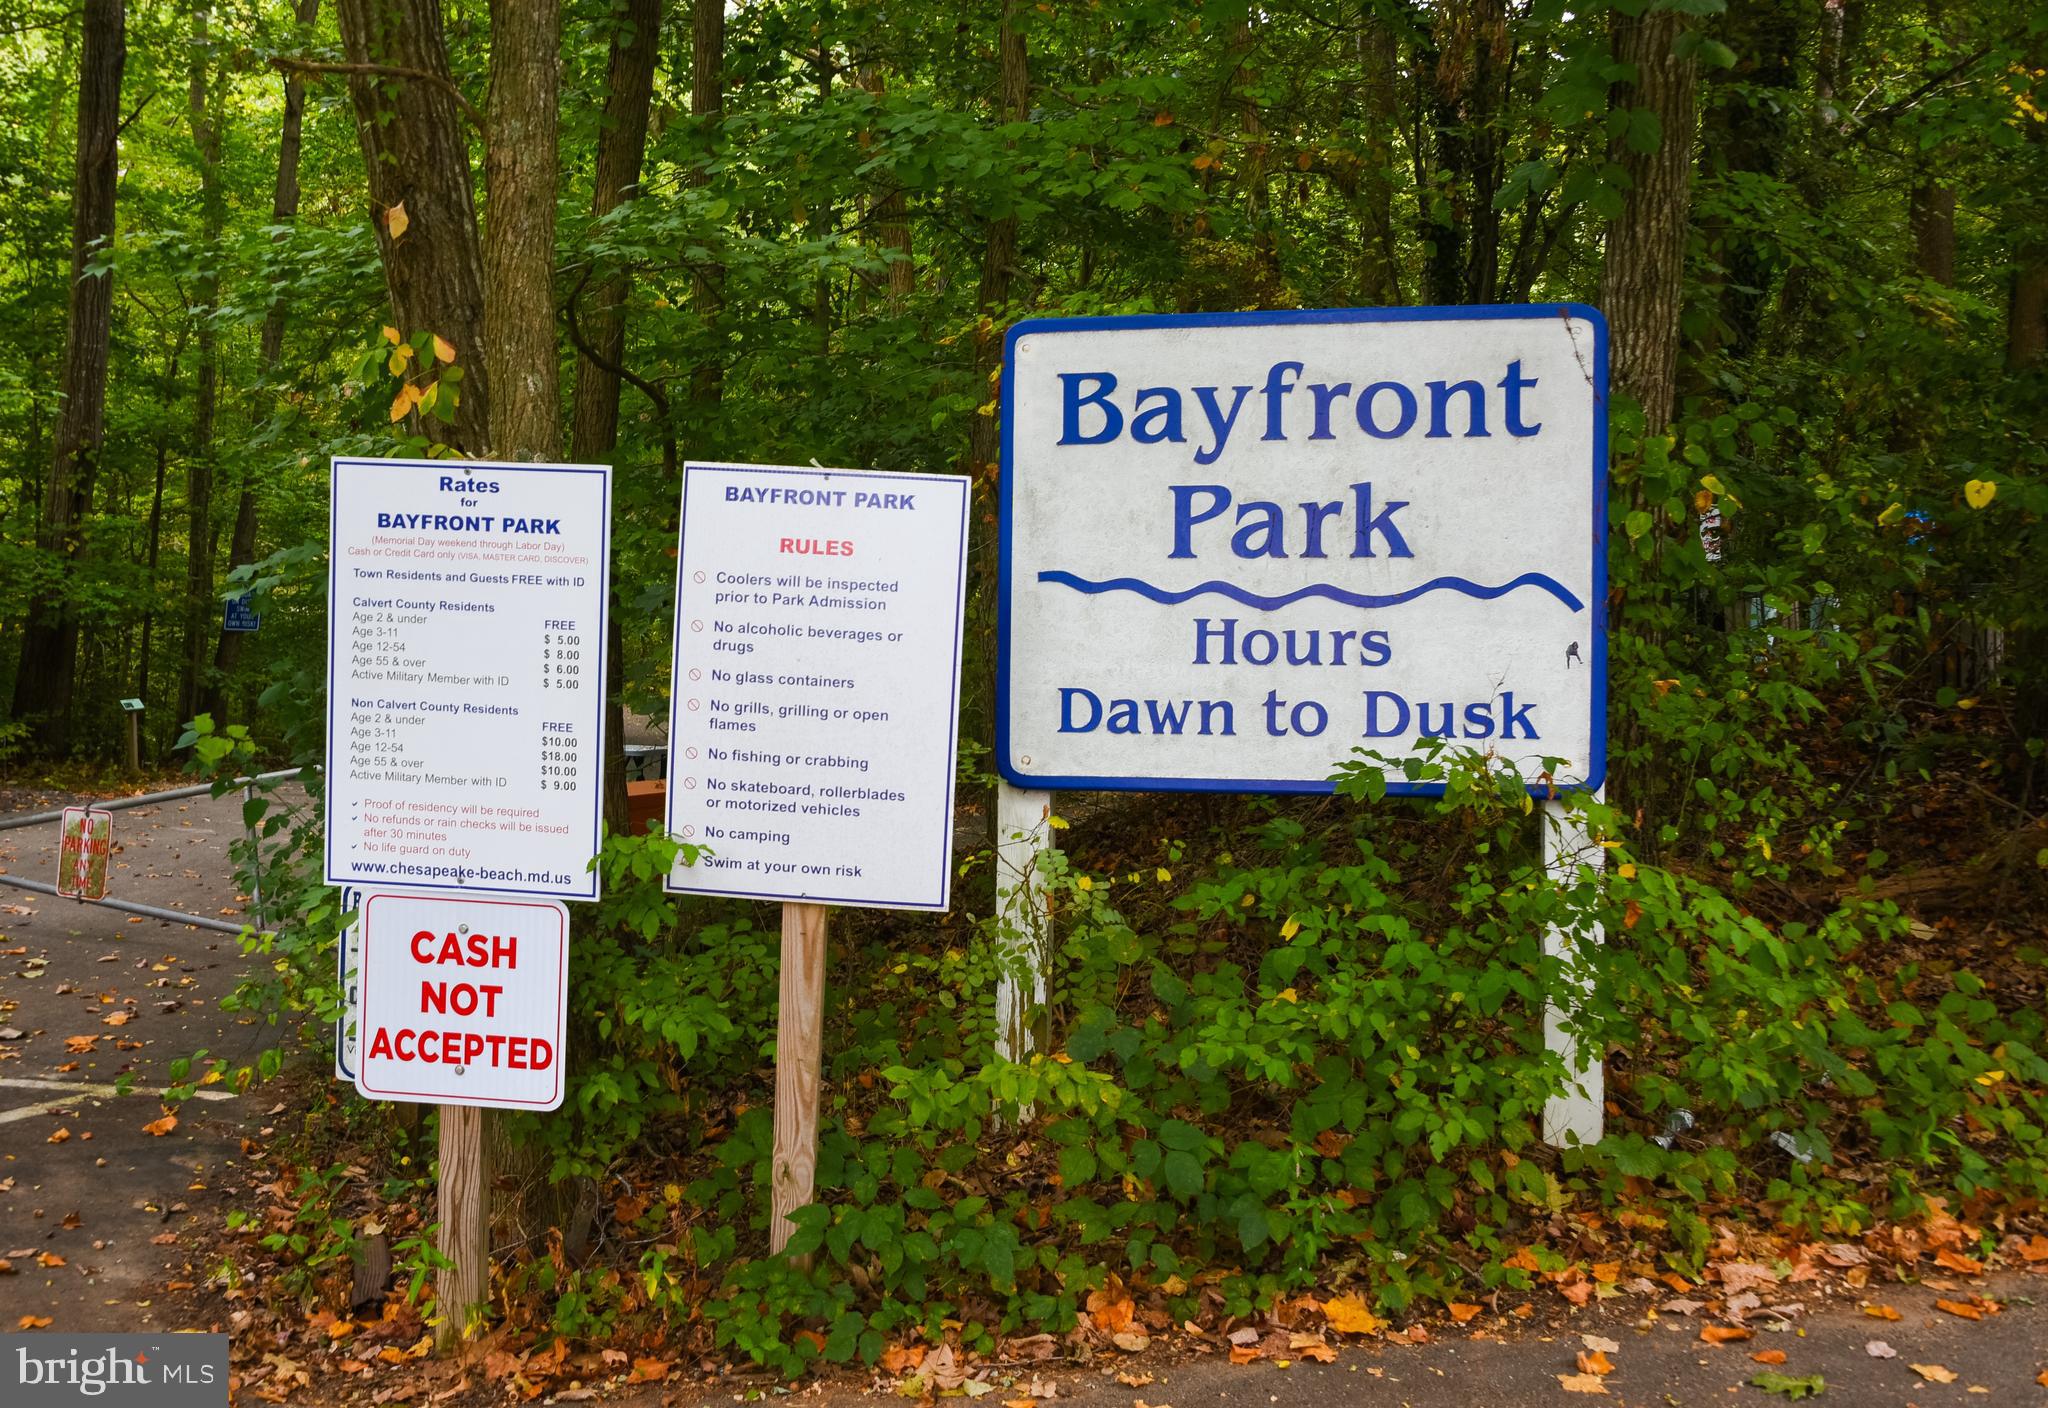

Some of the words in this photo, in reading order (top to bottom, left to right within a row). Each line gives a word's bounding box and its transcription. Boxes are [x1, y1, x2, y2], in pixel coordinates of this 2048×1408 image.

[1056, 359, 1542, 465] Bayfront
[440, 476, 500, 493] Rates
[460, 497, 478, 507] for
[725, 486, 847, 506] BAYFRONT
[855, 492, 915, 510] PARK
[378, 513, 495, 532] BAYFRONT
[503, 517, 560, 535] PARK
[1167, 482, 1415, 559] Park
[348, 546, 371, 556] Cash
[384, 547, 411, 559] Credit
[413, 549, 435, 559] Card
[437, 550, 456, 561] only
[372, 535, 416, 545] (Memorial
[417, 537, 435, 548] Day
[437, 539, 477, 548] weekend
[479, 539, 513, 551] through
[516, 541, 541, 550] Labor
[544, 541, 565, 553] Day)
[780, 538, 853, 556] RULES
[353, 568, 382, 578] Town
[386, 569, 442, 581] Residents
[445, 573, 466, 582] and
[469, 573, 509, 584] Guests
[512, 574, 542, 585] FREE
[546, 576, 569, 586] with
[573, 577, 585, 587] ID
[716, 571, 771, 586] Coolers
[777, 575, 800, 587] will
[805, 576, 822, 589] be
[827, 577, 898, 593] inspected
[353, 597, 392, 608] Calvert
[396, 599, 436, 612] County
[439, 600, 495, 612] Residents
[715, 590, 750, 605] prior
[754, 593, 767, 604] to
[772, 593, 804, 606] Park
[808, 595, 886, 610] Admission
[352, 611, 373, 624] Age
[397, 614, 427, 624] under
[545, 620, 575, 631] FREE
[352, 626, 373, 638] Age
[376, 626, 397, 637] 3-11
[557, 635, 580, 646] 5.00
[714, 620, 733, 633] No
[738, 622, 803, 637] alcoholic
[808, 625, 882, 643] beverages
[888, 633, 903, 642] or
[352, 640, 373, 653] Age
[377, 641, 405, 652] 12-54
[557, 650, 580, 660] 8.00
[713, 639, 754, 655] drugs
[1192, 618, 1392, 667] Hours
[351, 654, 373, 667] Age
[376, 655, 389, 666] 55
[403, 659, 426, 667] over
[556, 664, 579, 675] 6.00
[351, 669, 383, 680] Active
[386, 670, 424, 684] Military
[427, 672, 470, 685] Member
[473, 676, 494, 685] with
[498, 676, 509, 686] ID
[556, 679, 579, 689] 5.00
[712, 669, 731, 682] No
[736, 671, 773, 685] glass
[778, 675, 855, 689] containers
[351, 698, 373, 708] Non
[377, 699, 416, 710] Calvert
[420, 701, 460, 715] County
[463, 703, 519, 715] Residents
[710, 699, 729, 712] No
[734, 702, 773, 716] grills,
[778, 704, 828, 721] grilling
[833, 709, 849, 719] or
[853, 711, 888, 723] open
[1057, 688, 1236, 736] Dawn
[1262, 689, 1328, 737] to
[1362, 691, 1541, 740] Dusk
[350, 712, 371, 725] Age
[396, 715, 425, 725] under
[542, 722, 573, 733] FREE
[709, 717, 756, 732] flames
[350, 726, 371, 739] Age
[374, 727, 396, 738] 3-11
[542, 736, 577, 748] $10.00
[350, 741, 371, 753] Age
[375, 742, 403, 753] 12-54
[541, 750, 577, 762] $18.00
[708, 748, 727, 760] No
[732, 749, 781, 767] fishing
[785, 755, 801, 765] or
[805, 755, 868, 772] crabbing
[350, 755, 371, 768] Age
[374, 756, 387, 766] 55
[401, 760, 424, 768] over
[541, 765, 577, 777] $10.00
[349, 769, 382, 780] Active
[385, 771, 422, 785] Military
[425, 773, 468, 786] Member
[471, 776, 492, 787] with
[495, 777, 507, 787] ID
[553, 780, 576, 791] 9.00
[707, 778, 726, 790] No
[731, 780, 814, 798] skateboard,
[820, 786, 905, 802] rollerblades
[364, 798, 393, 810] Proof
[395, 800, 405, 810] of
[408, 802, 458, 815] residency
[460, 804, 477, 814] will
[480, 805, 493, 815] be
[497, 808, 539, 819] required
[706, 799, 721, 808] or
[725, 800, 796, 813] motorized
[801, 803, 860, 817] vehicles
[80, 818, 94, 835] NO
[364, 813, 379, 823] No
[382, 814, 421, 826] refunds
[422, 818, 435, 826] or
[437, 818, 457, 827] rain
[460, 818, 497, 830] checks
[499, 821, 516, 831] will
[535, 822, 569, 834] issued
[364, 827, 387, 838] after
[390, 828, 403, 839] 30
[406, 830, 447, 841] minutes
[705, 826, 724, 838] No
[729, 830, 790, 846] camping
[64, 836, 107, 855] PARKING
[364, 841, 378, 852] No
[381, 842, 396, 853] life
[399, 845, 429, 856] guard
[432, 847, 445, 855] on
[448, 847, 471, 859] duty
[73, 859, 93, 871] ANY
[351, 861, 571, 885] www.chesapeake-beach.md.us
[704, 856, 742, 869] Swim
[747, 860, 760, 871] at
[764, 863, 797, 874] your
[801, 865, 831, 875] own
[836, 865, 862, 877] risk
[73, 876, 92, 888] TIME
[410, 930, 517, 969] CASH
[421, 981, 503, 1018] NOT
[369, 1027, 553, 1070] ACCEPTED
